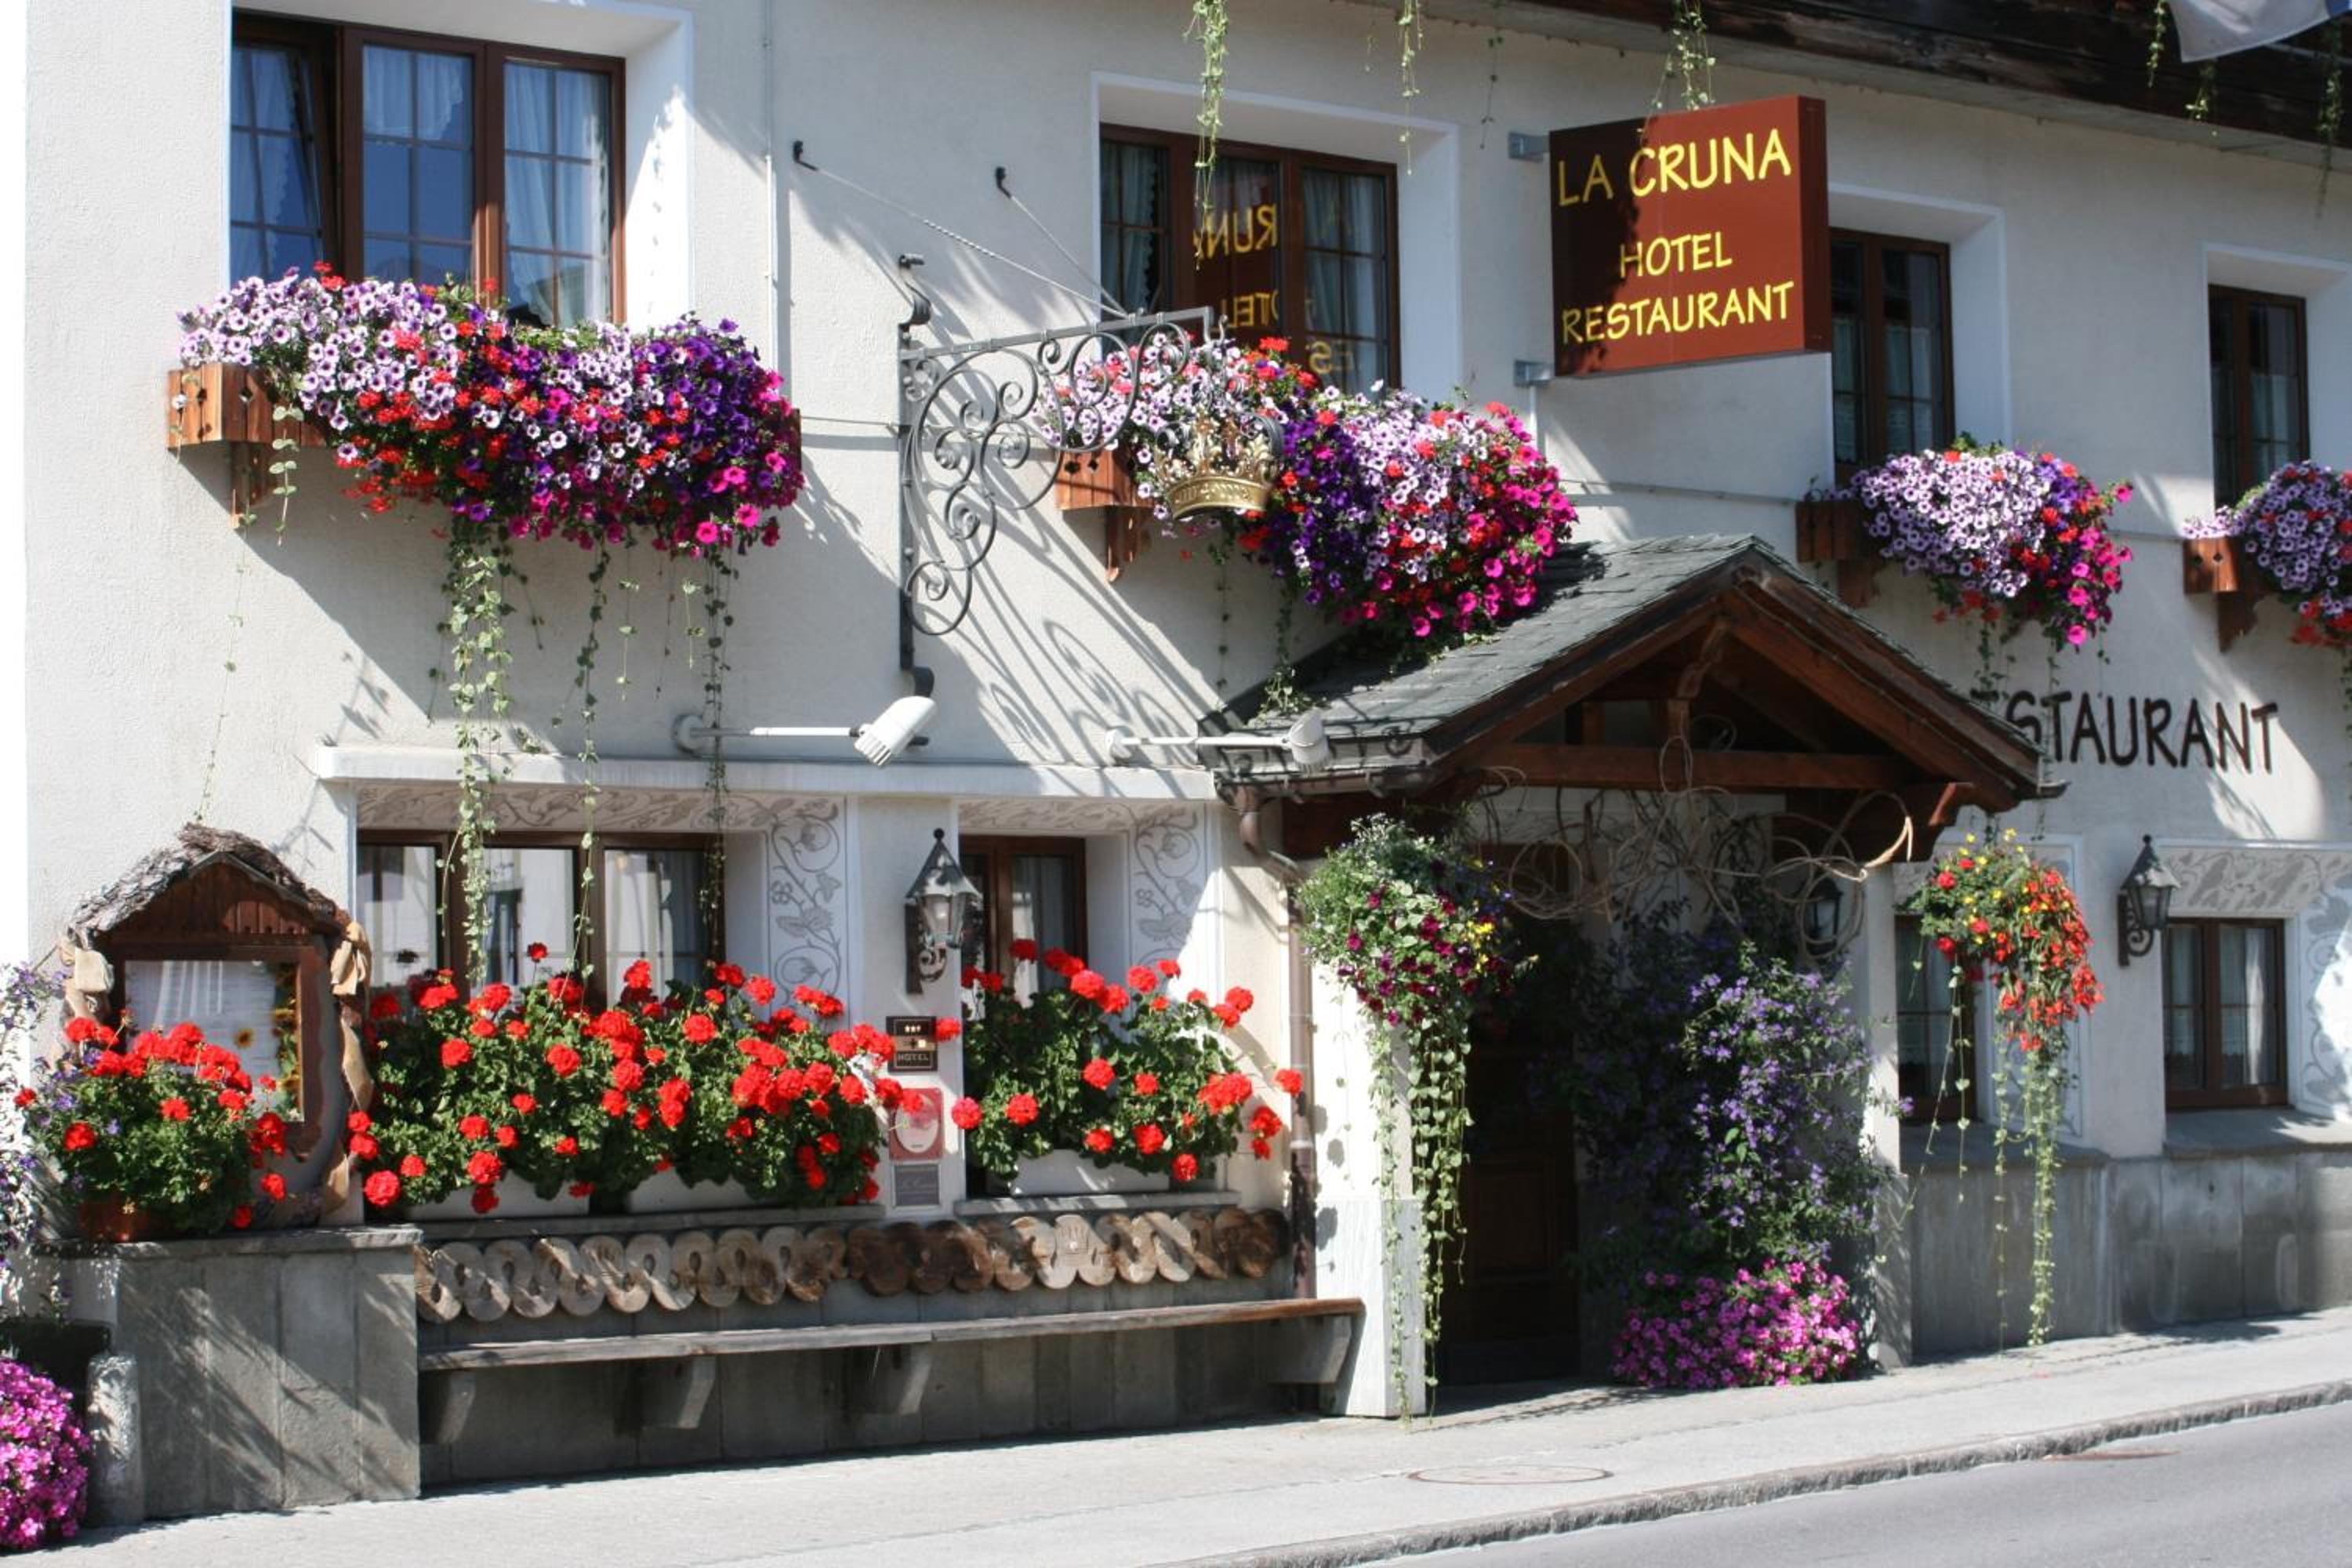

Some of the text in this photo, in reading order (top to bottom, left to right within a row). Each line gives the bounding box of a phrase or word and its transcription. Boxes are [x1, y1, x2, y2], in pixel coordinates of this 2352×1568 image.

[1559, 128, 1792, 206] LA CRUNA
[1619, 231, 1733, 278] HOTEL
[1563, 281, 1795, 343] RESTAURANT
[1970, 688, 2278, 773] STAURANT
[898, 1053, 929, 1062] HOTEL
